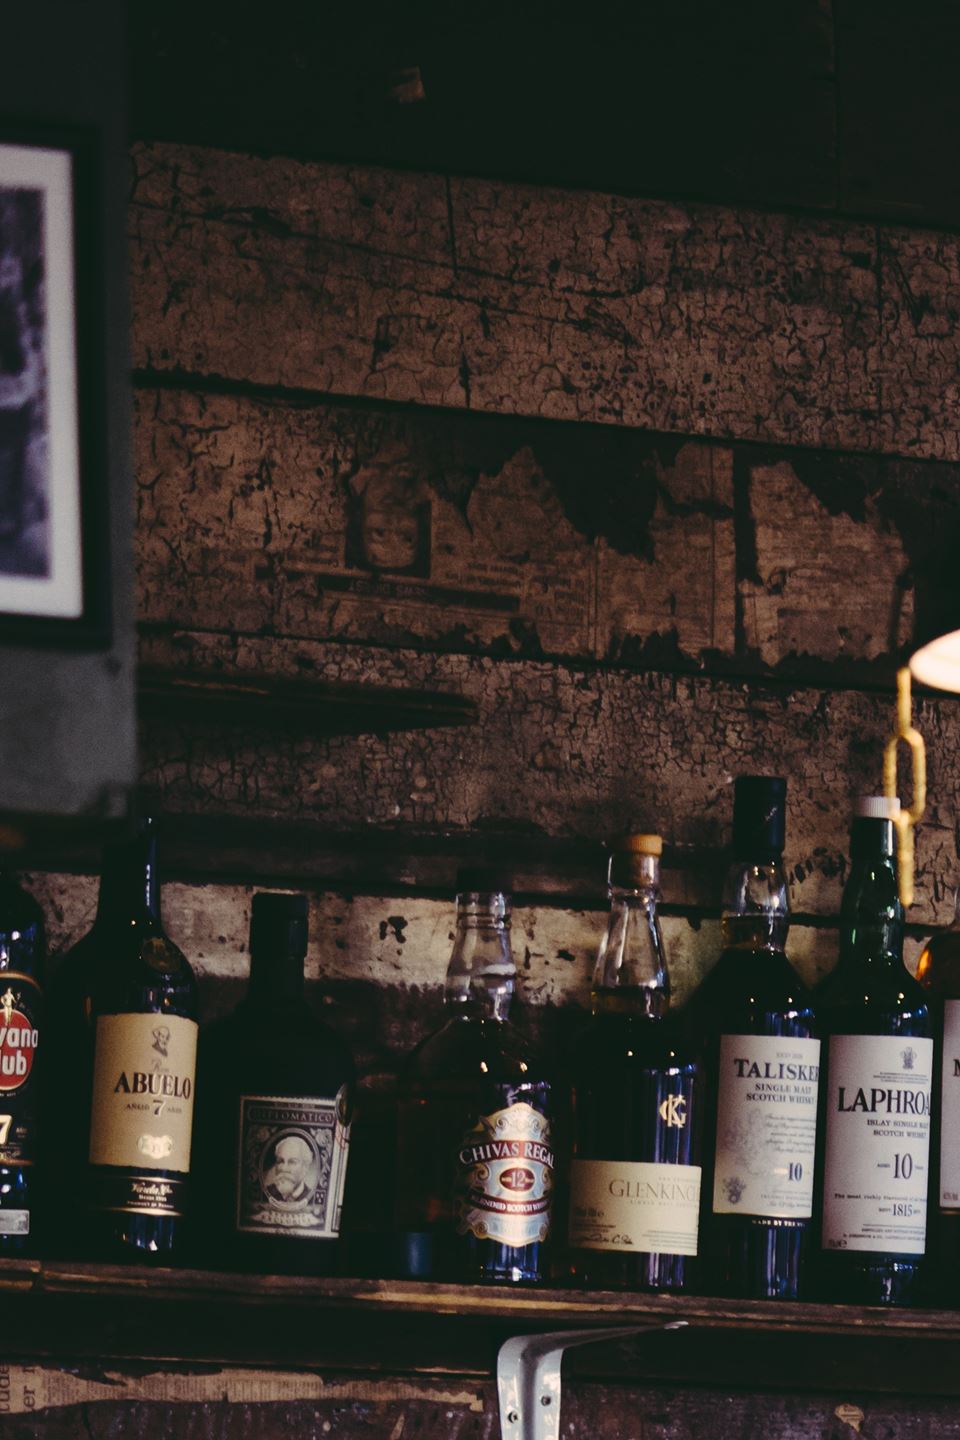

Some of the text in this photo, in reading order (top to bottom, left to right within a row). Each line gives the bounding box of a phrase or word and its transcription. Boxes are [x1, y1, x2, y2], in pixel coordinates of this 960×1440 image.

[114, 1071, 192, 1100] ABUELO
[755, 1083, 792, 1094] SINGLE
[746, 1093, 786, 1103] SCOTCH
[153, 1100, 165, 1116] 7
[867, 1119, 891, 1127] ISLAY
[873, 1129, 905, 1138] SCOTCH
[459, 1142, 520, 1166] CHIVAS
[787, 1162, 803, 1182] 10
[893, 1153, 913, 1180] 10
[510, 1170, 527, 1188] 12
[892, 1203, 914, 1217] 1815
